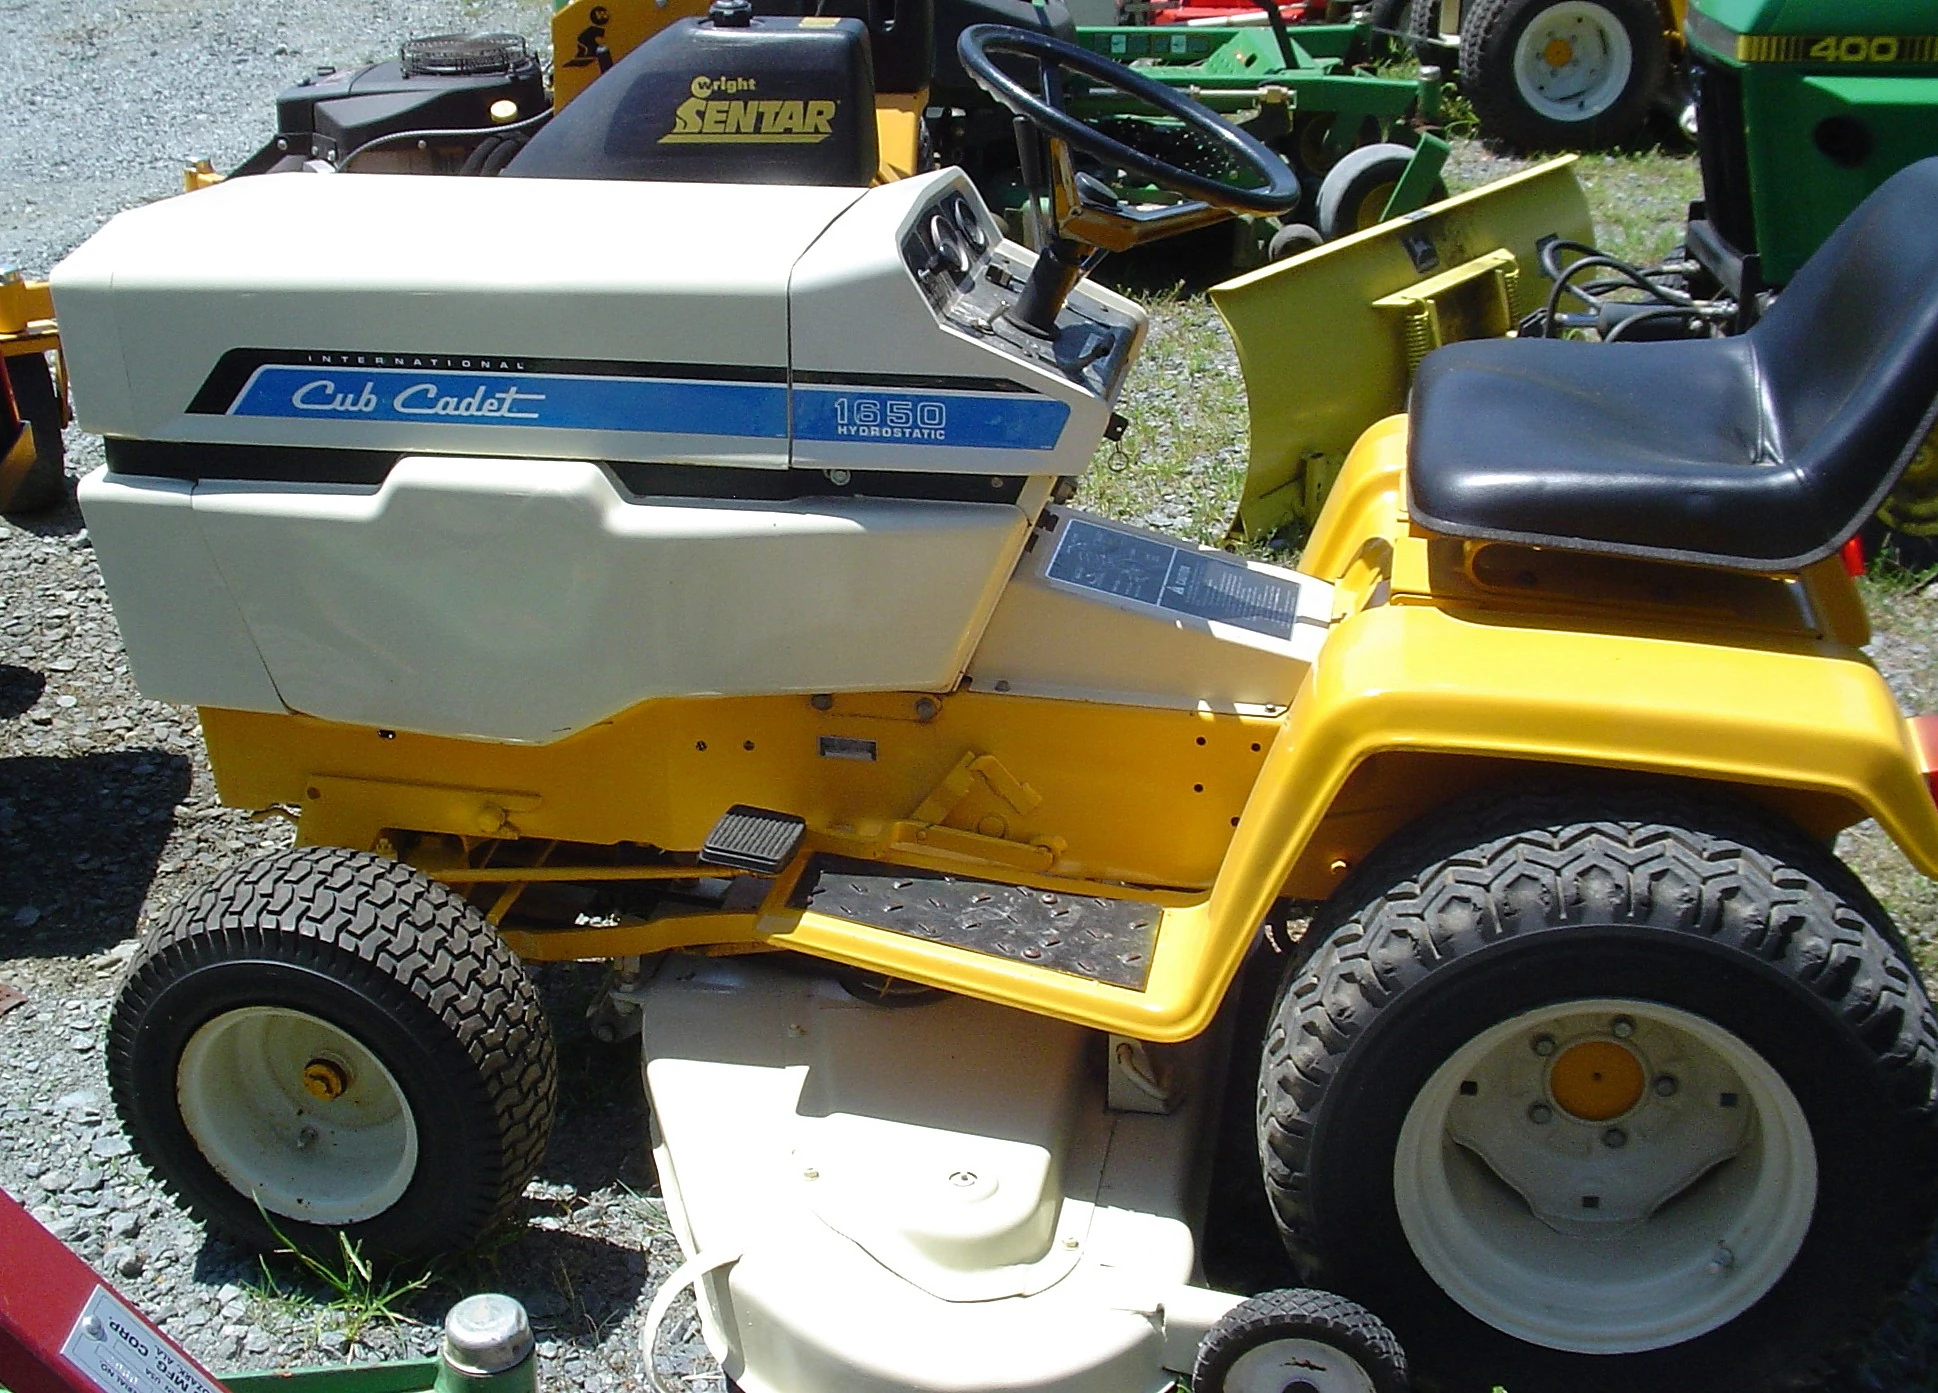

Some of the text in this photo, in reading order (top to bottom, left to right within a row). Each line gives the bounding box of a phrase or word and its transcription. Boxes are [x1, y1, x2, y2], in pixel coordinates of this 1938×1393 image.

[1810, 36, 1898, 62] 400
[672, 98, 837, 134] SENTAR
[307, 354, 525, 370] INTERNATIONAL
[292, 380, 546, 419] Cub Cadet
[835, 398, 946, 428] 1650
[837, 424, 946, 441] HYDROSTATIC
[109, 1316, 149, 1357] CORP.
[155, 1356, 189, 1392] MFG.
